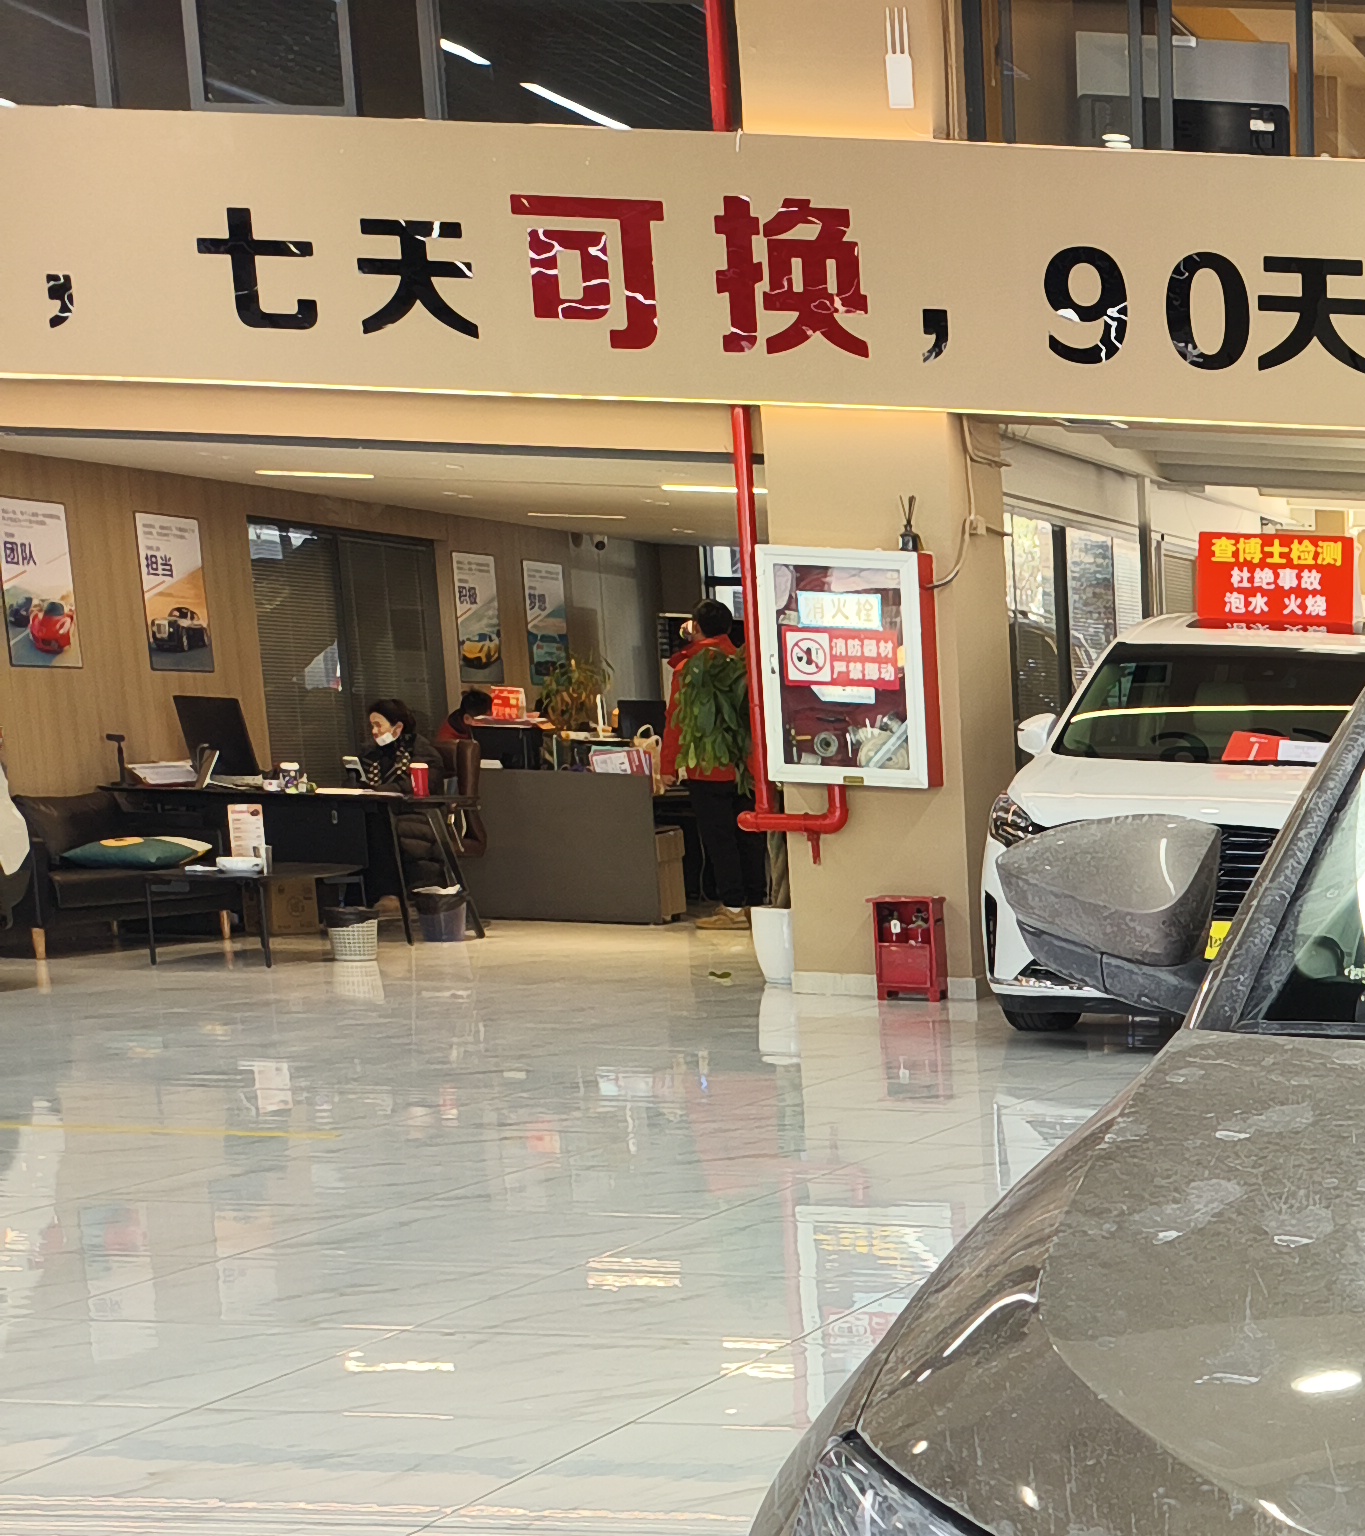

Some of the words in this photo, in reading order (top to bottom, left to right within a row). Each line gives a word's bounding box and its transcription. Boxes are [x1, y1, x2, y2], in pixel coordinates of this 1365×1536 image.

[3, 540, 37, 567] 团队
[1211, 536, 1342, 567] 查博士检测
[145, 553, 174, 579] 担当
[1231, 566, 1322, 590] 杜绝事故
[804, 596, 875, 624] 消火栓
[1224, 592, 1270, 615] 泡水
[1283, 593, 1328, 617] 火烧
[831, 638, 894, 659] 消防器材
